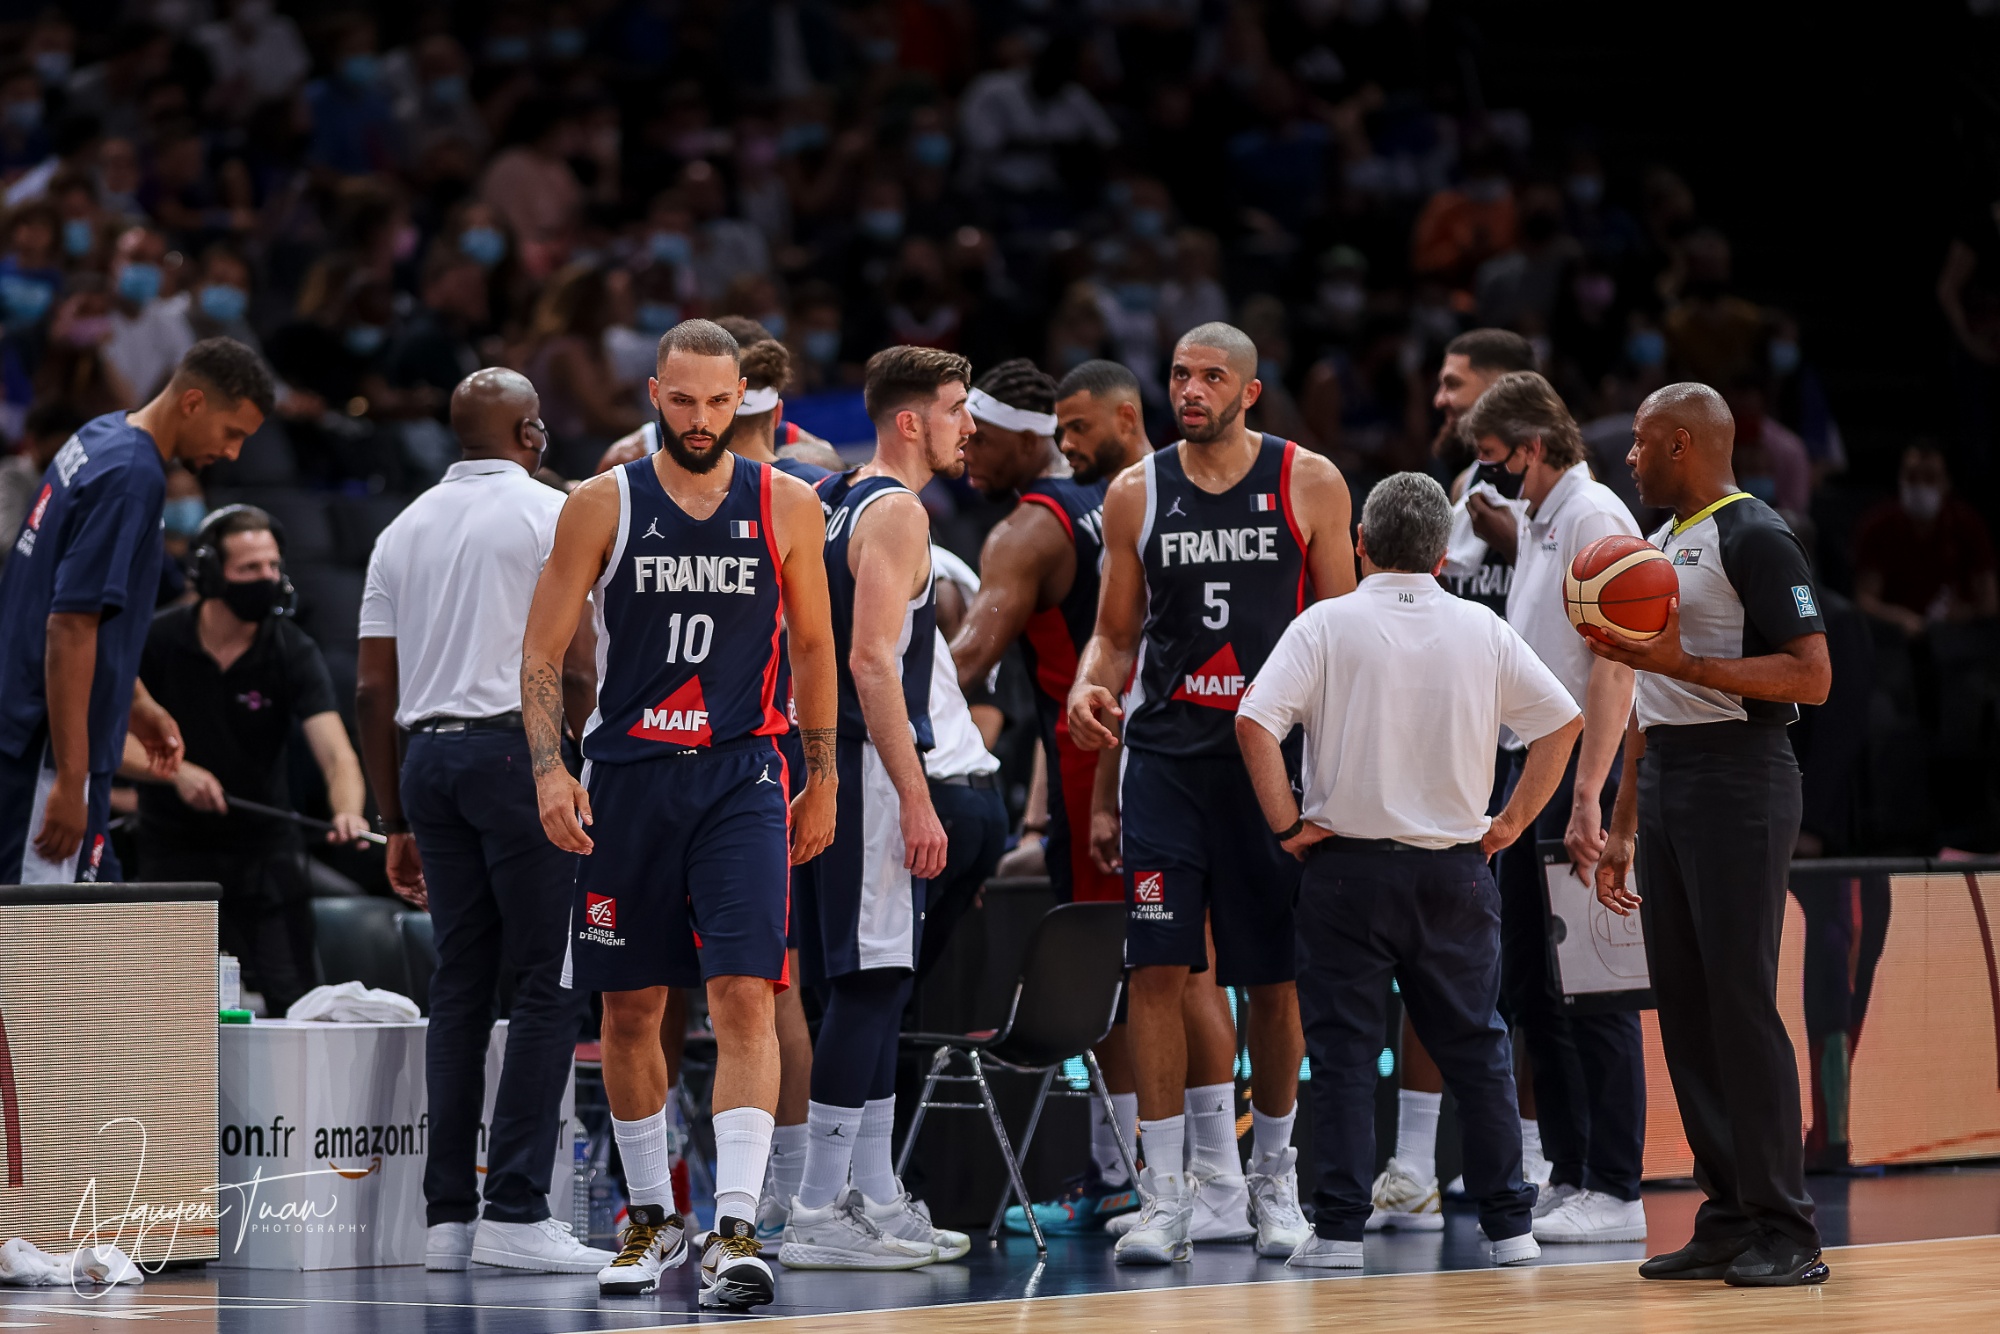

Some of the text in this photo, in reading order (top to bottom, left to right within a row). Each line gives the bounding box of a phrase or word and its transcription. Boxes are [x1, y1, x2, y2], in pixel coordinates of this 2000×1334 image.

[1160, 527, 1279, 567] FRANCE
[634, 555, 760, 595] FRANCE
[1202, 582, 1231, 630] 5
[1398, 592, 1415, 604] PAD
[666, 612, 715, 664] 10
[1185, 674, 1246, 696] MAIF
[642, 708, 709, 732] MAIF
[579, 931, 626, 946] D'EPARGNE
[588, 926, 615, 938] CAISSE
